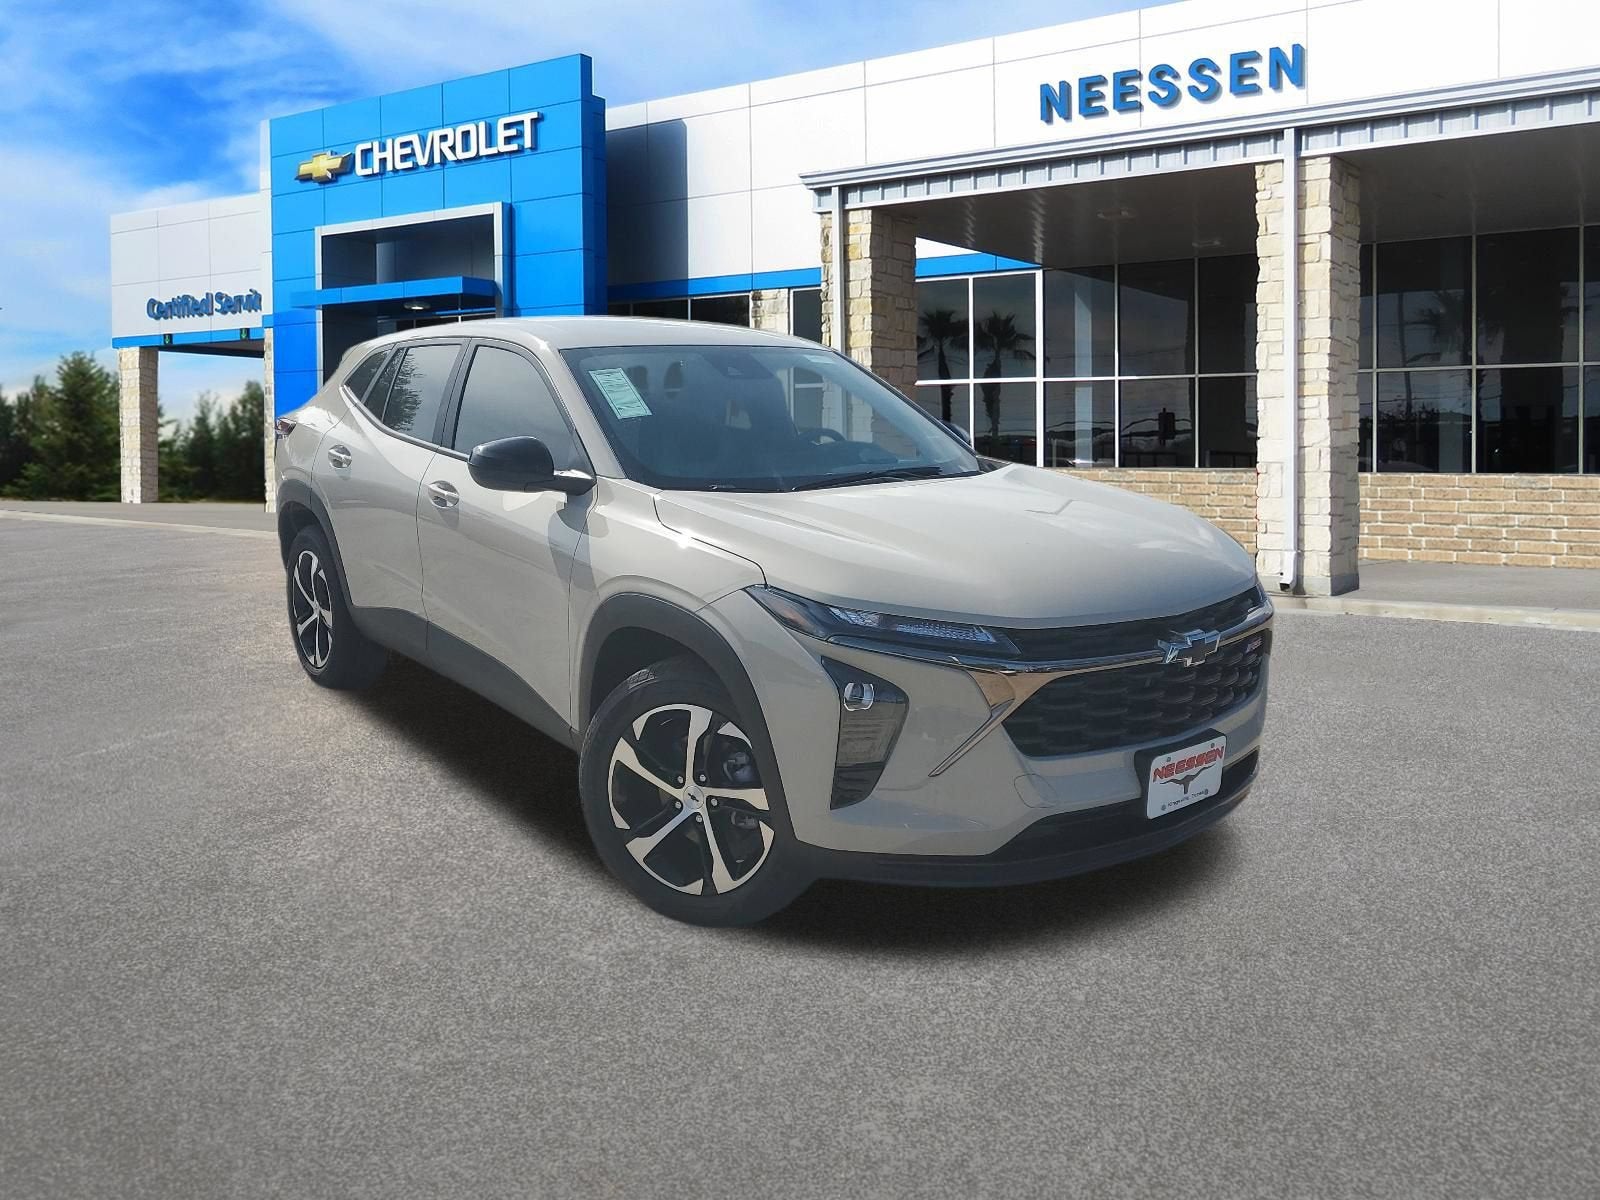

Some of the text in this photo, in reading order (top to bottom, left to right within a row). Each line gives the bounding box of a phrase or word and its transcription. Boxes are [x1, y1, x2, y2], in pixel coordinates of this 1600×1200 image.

[1040, 43, 1305, 124] NEESSEN
[354, 111, 542, 177] CHEVROLET
[147, 292, 214, 320] Certified
[1153, 746, 1225, 783] NEESSEN
